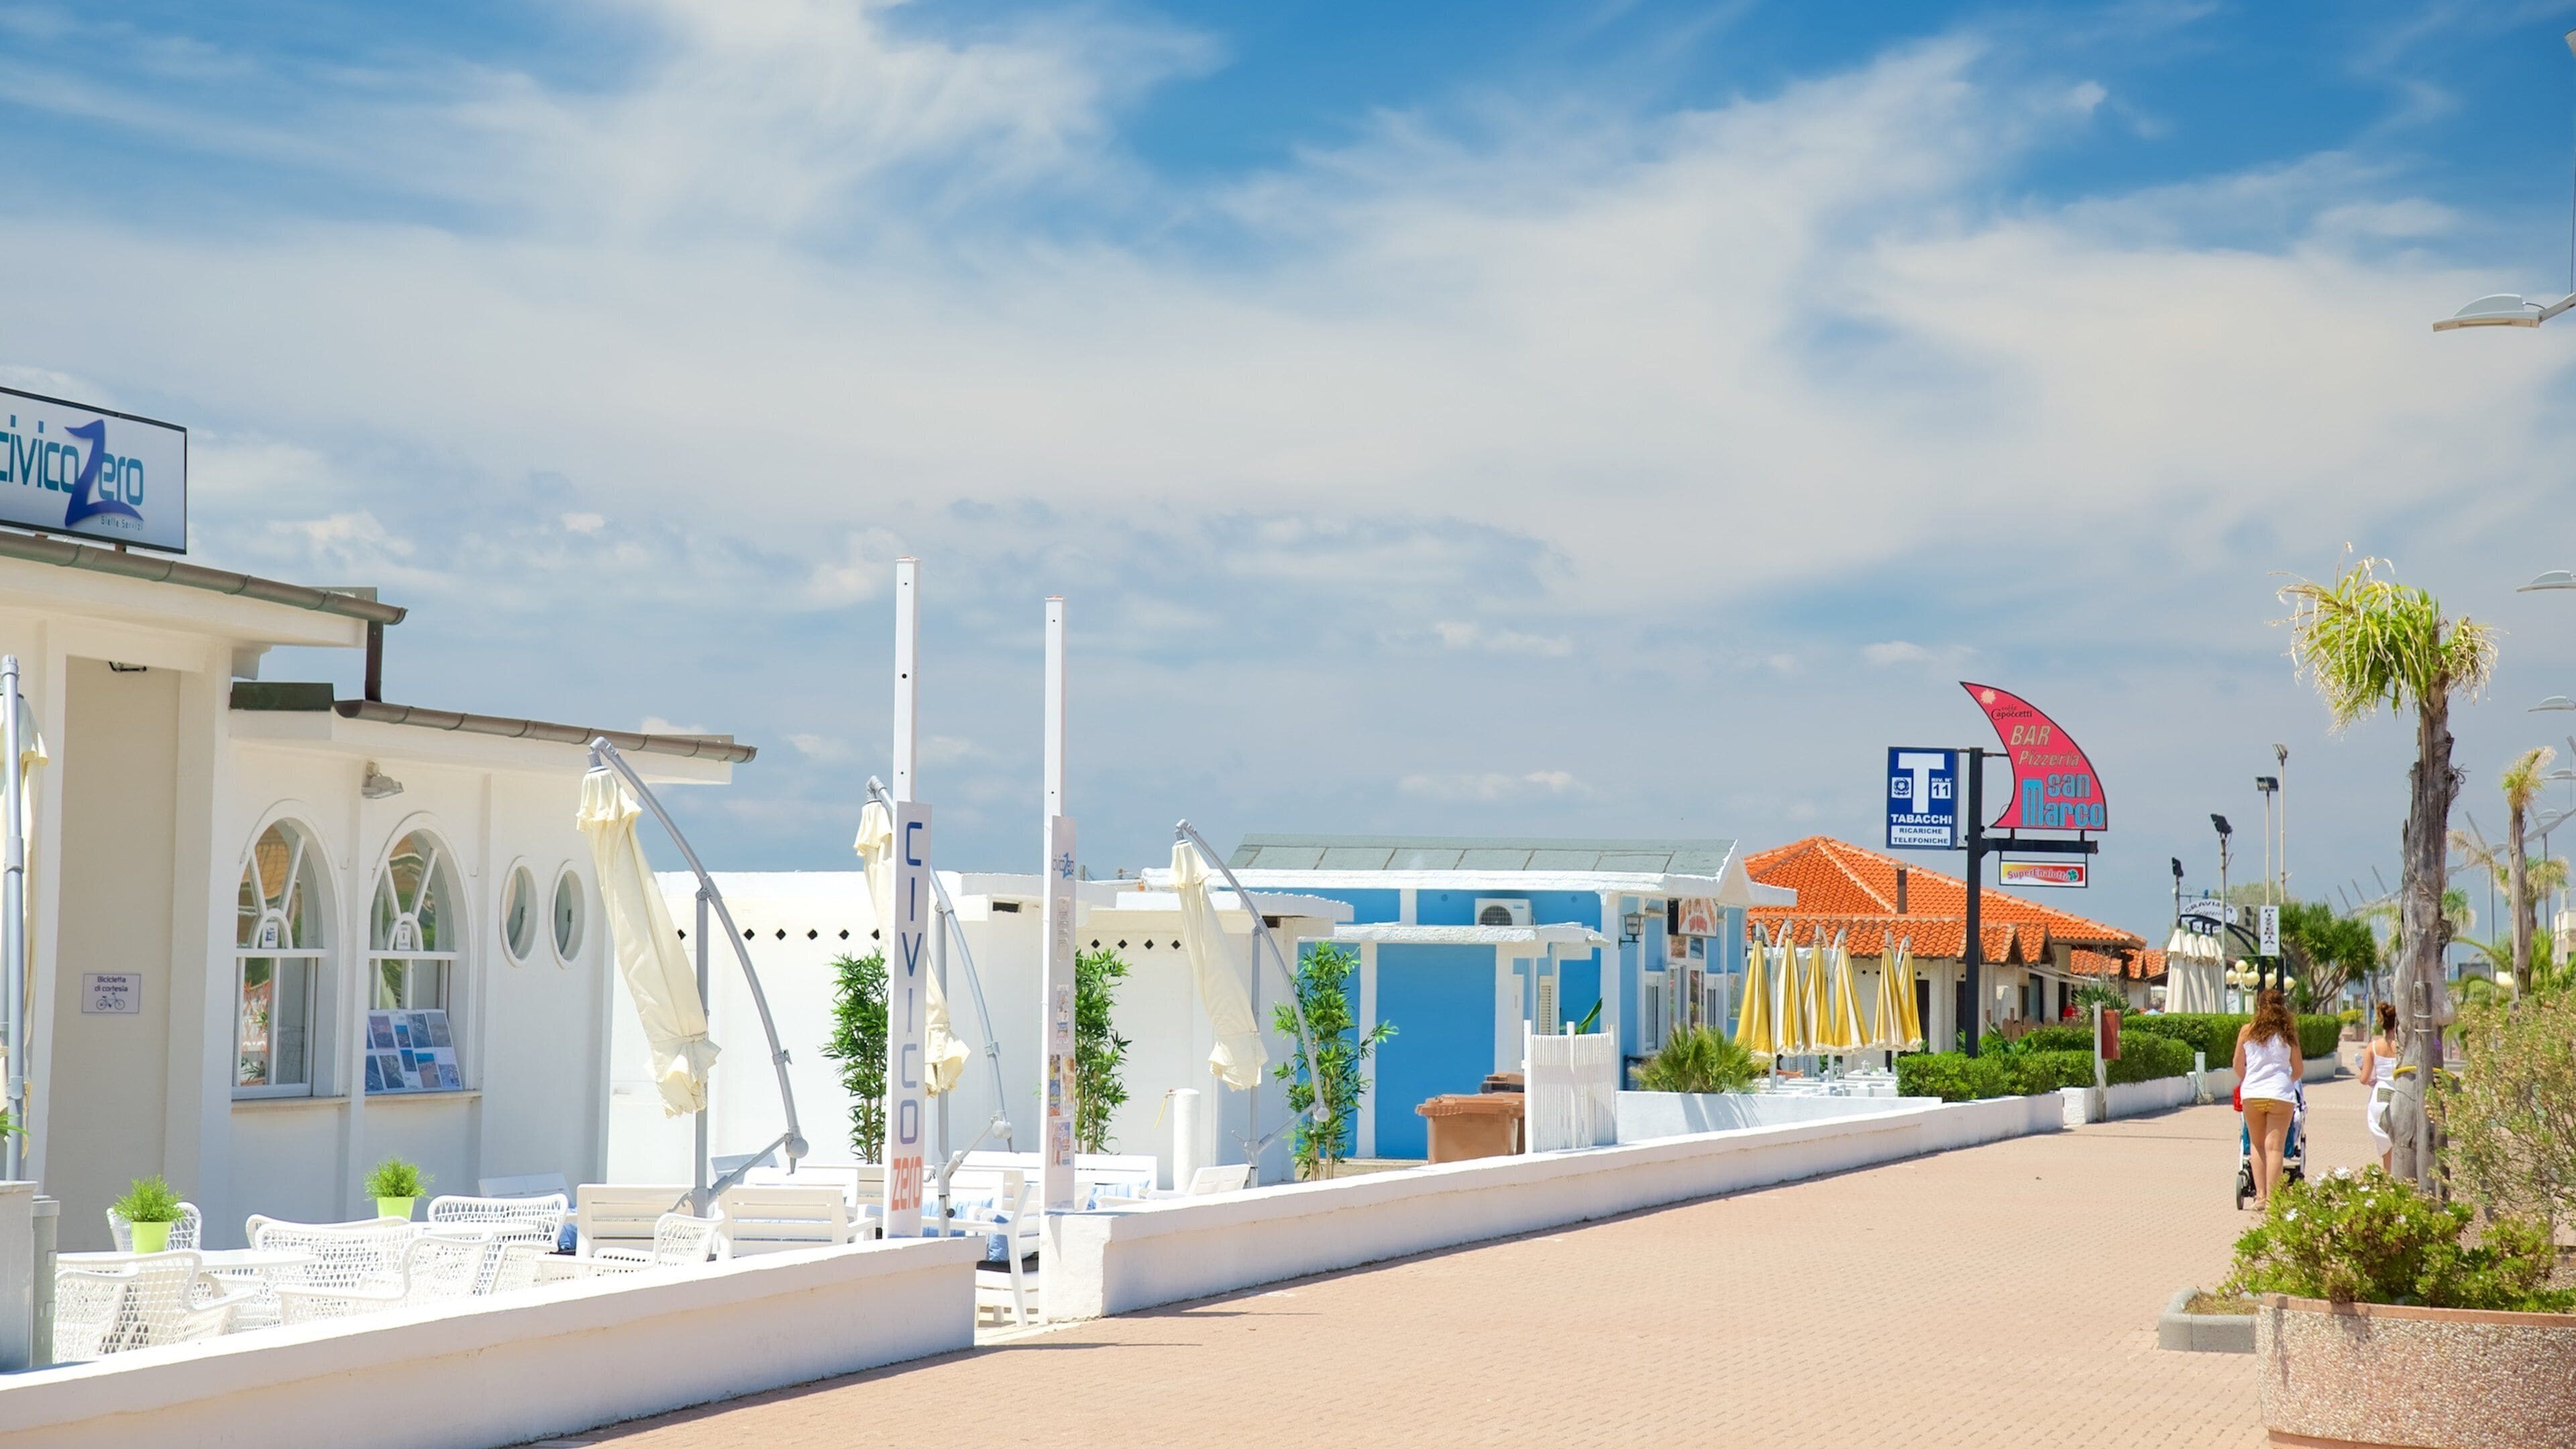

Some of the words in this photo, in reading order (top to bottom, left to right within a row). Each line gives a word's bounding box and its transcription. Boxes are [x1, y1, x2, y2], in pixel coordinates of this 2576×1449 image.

[2009, 724, 2051, 745] BAR
[2018, 749, 2080, 766] Pizzeria
[1898, 752, 1945, 814] T
[1933, 784, 1949, 796] 11
[2047, 773, 2090, 798] san
[2021, 778, 2105, 826] Marco
[1890, 814, 1952, 824] TABACCHI
[900, 821, 922, 1144] CIVICO
